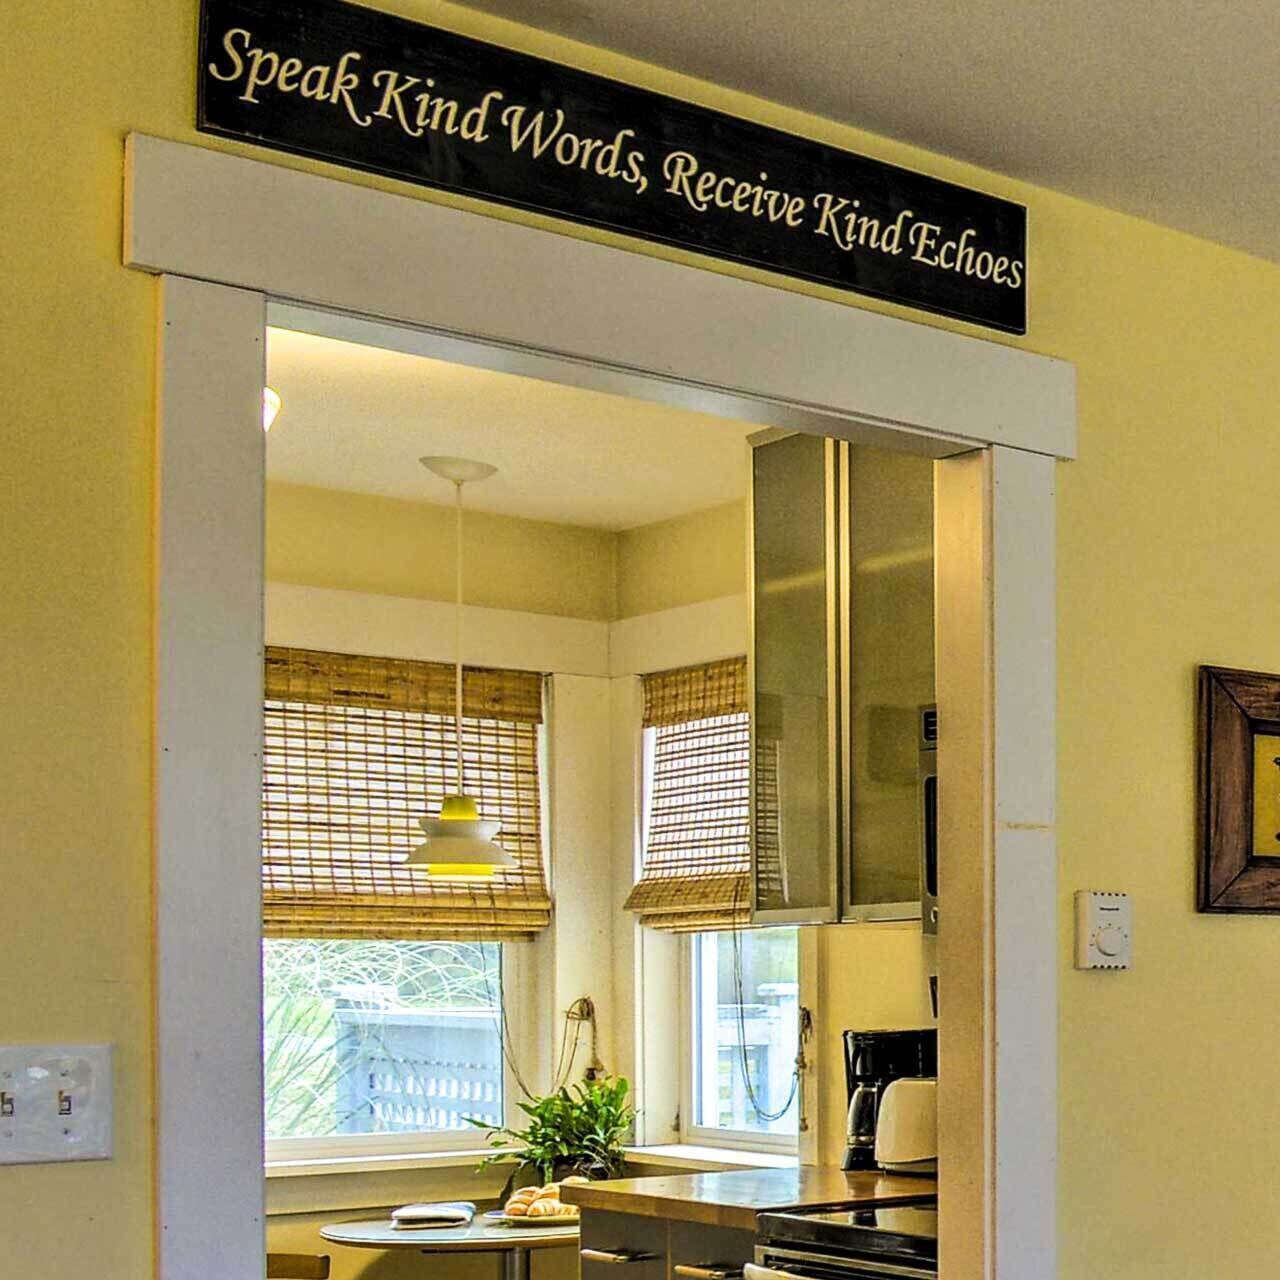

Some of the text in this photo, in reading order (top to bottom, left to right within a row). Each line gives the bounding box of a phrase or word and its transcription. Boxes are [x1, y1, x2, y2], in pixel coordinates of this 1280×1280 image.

[208, 27, 1024, 289] Speak Kind Words, Receive Kind Echoes
